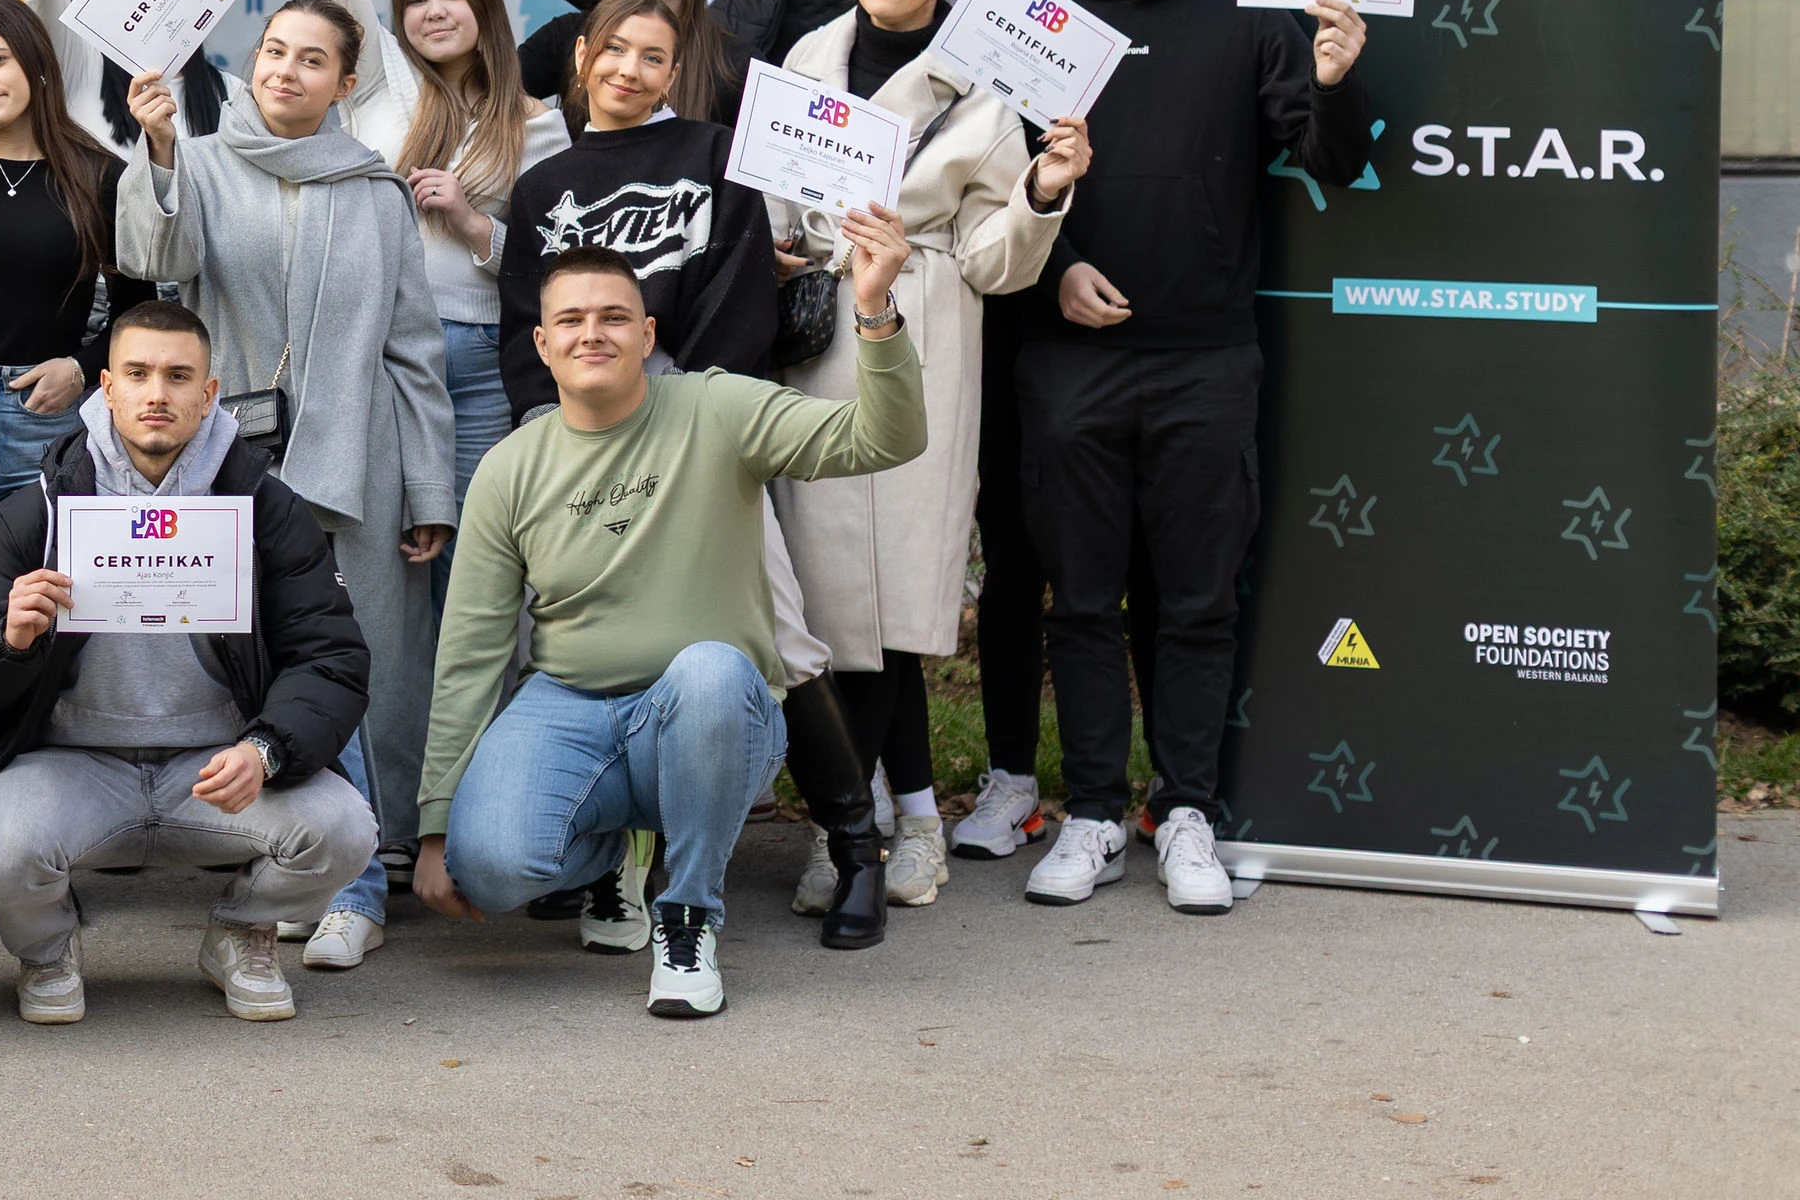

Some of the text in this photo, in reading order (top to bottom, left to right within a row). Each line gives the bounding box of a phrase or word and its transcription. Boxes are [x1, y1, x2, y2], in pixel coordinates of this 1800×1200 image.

[1026, 2, 1067, 32] LAB
[986, 10, 1077, 74] CERTIFIKAT
[808, 102, 849, 127] LAB
[770, 121, 875, 165] CERTIFIKAT
[1411, 123, 1665, 183] S.T.A.R.
[1344, 285, 1587, 314] WWW.STAR.STUDY
[566, 473, 659, 516] High Quality
[131, 519, 177, 538] LAB
[94, 555, 215, 568] CERTIFIKAT
[137, 571, 174, 580] Ajas Konjić
[1464, 622, 1611, 650] OPEN SOCIETY
[1336, 656, 1370, 666] MUNJA
[1475, 645, 1610, 671] FOUNDATIONS
[1517, 669, 1608, 684] WESTERN BALKANS
